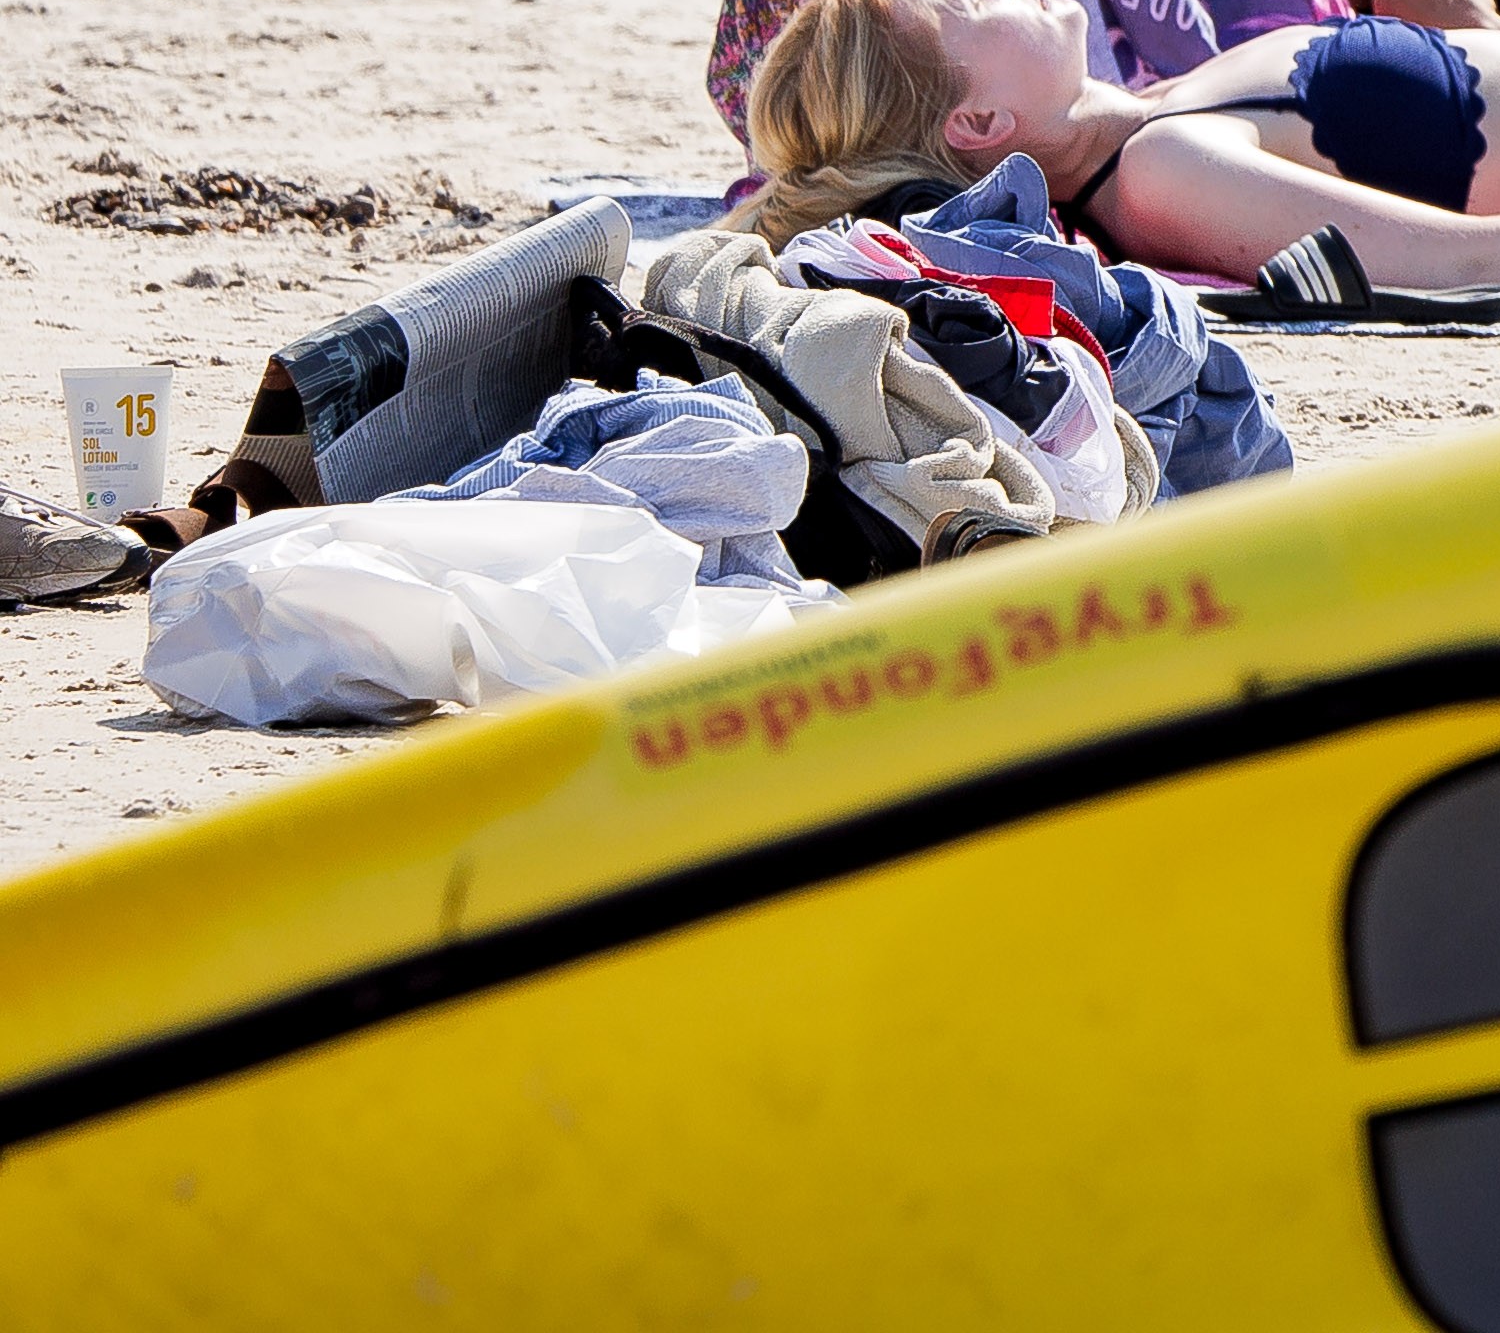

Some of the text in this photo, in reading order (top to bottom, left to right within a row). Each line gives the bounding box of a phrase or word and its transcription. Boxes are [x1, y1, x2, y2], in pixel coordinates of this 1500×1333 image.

[116, 393, 156, 438] 15
[82, 437, 102, 450] SOL
[82, 451, 118, 464] LOTION
[630, 571, 1241, 770] TrygFonden
